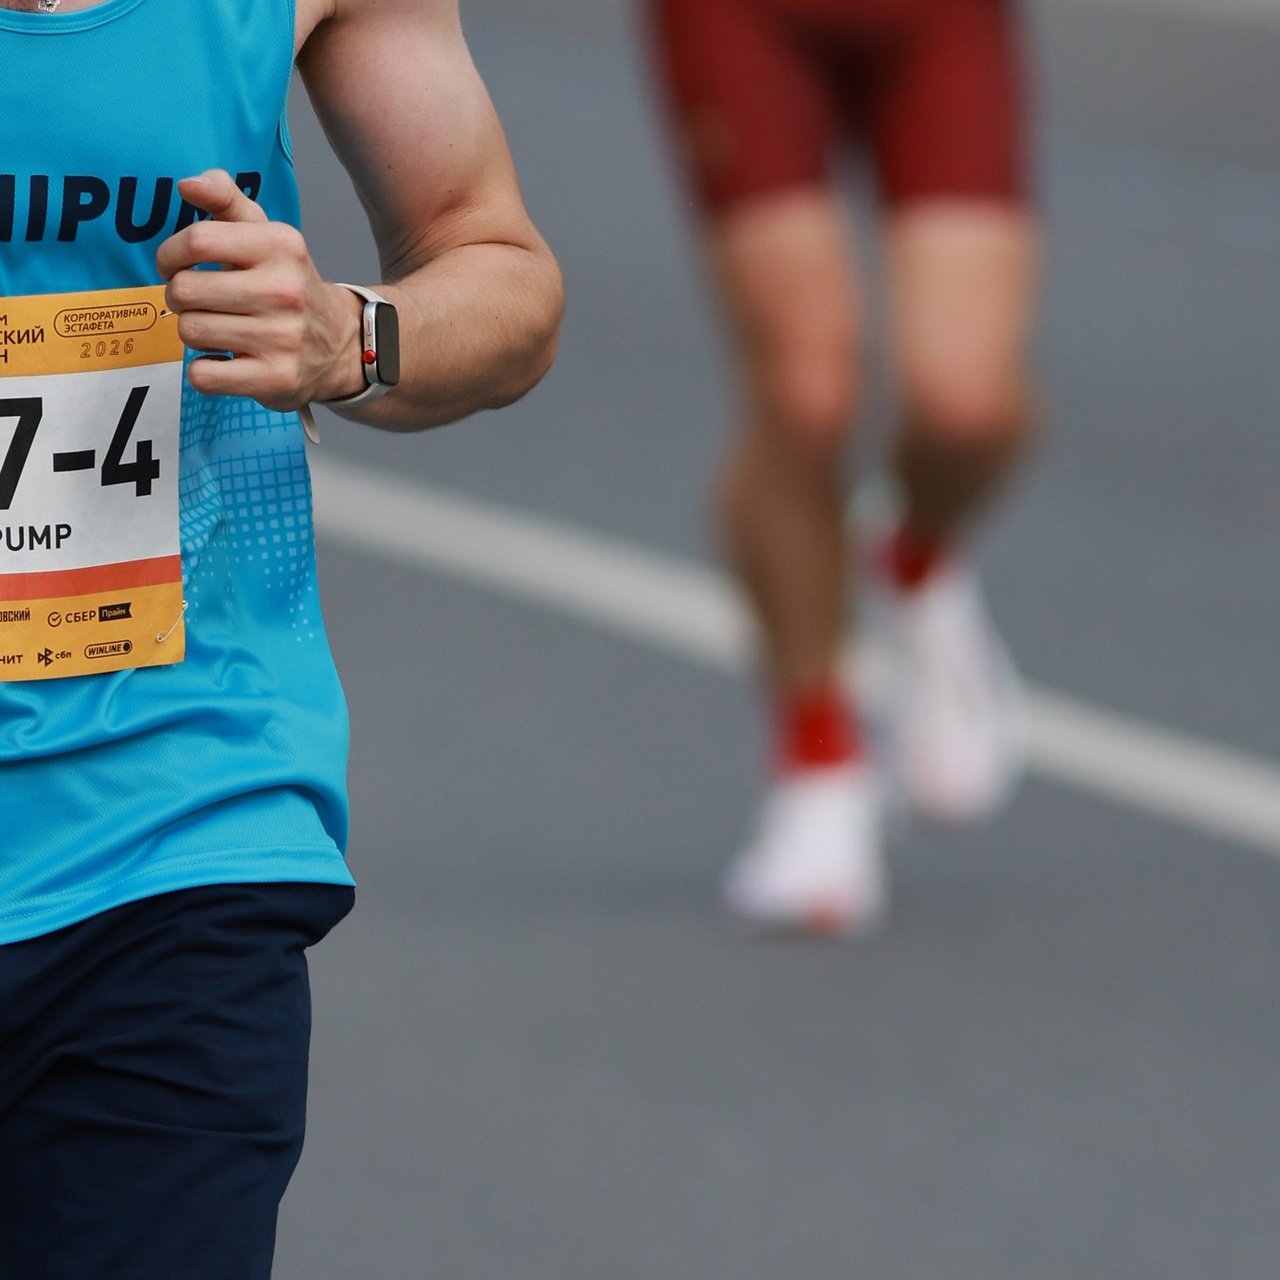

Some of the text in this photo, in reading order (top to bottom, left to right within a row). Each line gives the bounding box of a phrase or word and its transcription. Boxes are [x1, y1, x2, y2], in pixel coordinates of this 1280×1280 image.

[63, 307, 148, 323] КОРПОРАТИВНАЯ
[64, 321, 115, 333] ЭСТАФЕТА
[80, 338, 134, 359] 2026
[64, 607, 126, 624] СБЕР Прайм
[88, 643, 122, 656] WINLINE
